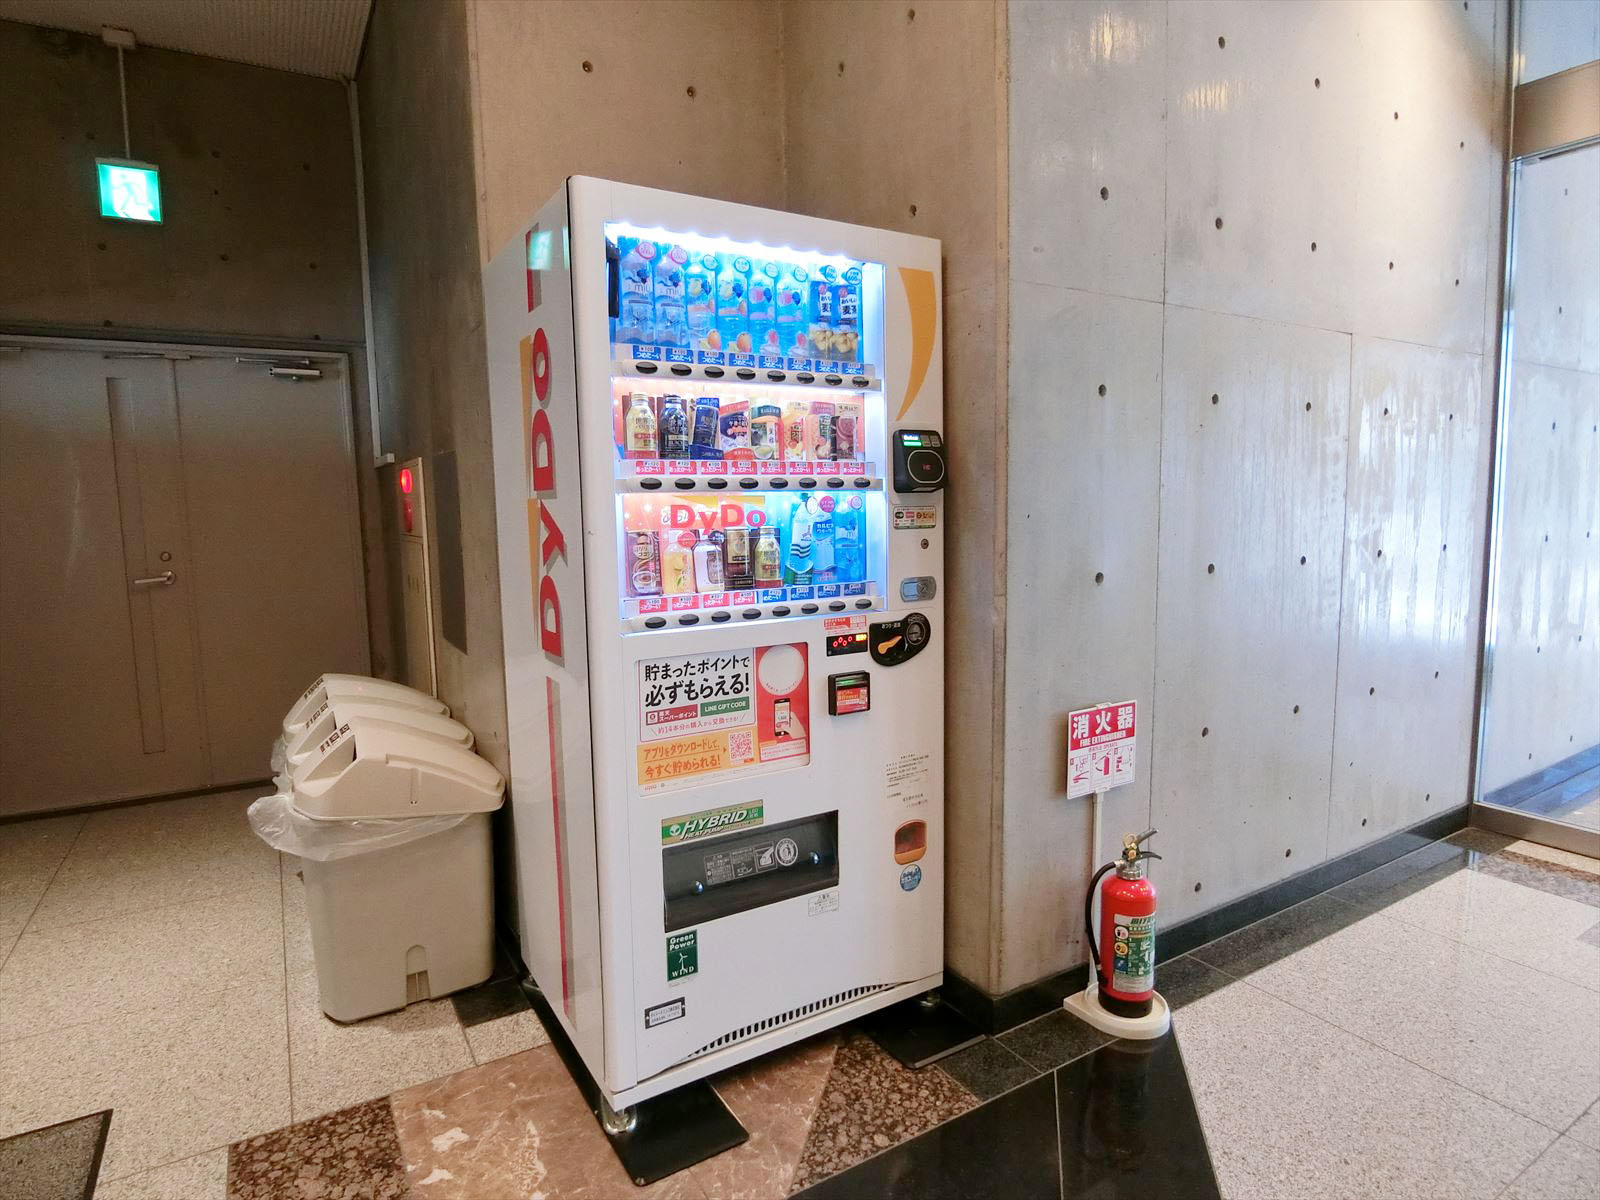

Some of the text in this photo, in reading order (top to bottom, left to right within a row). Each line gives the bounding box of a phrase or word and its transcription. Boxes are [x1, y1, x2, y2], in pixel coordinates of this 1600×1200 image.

[531, 327, 565, 657] DyDo
[670, 504, 767, 535] DyDo
[644, 655, 750, 682] 貯まったポイントで
[645, 672, 750, 707] 必ずもらえる!
[704, 700, 747, 713] LINE GIFT CODE
[1072, 705, 1134, 740] 消火器
[682, 810, 749, 840] HYBRID
[669, 933, 694, 944] Green
[669, 939, 695, 951] Power
[671, 966, 695, 977] WIND
